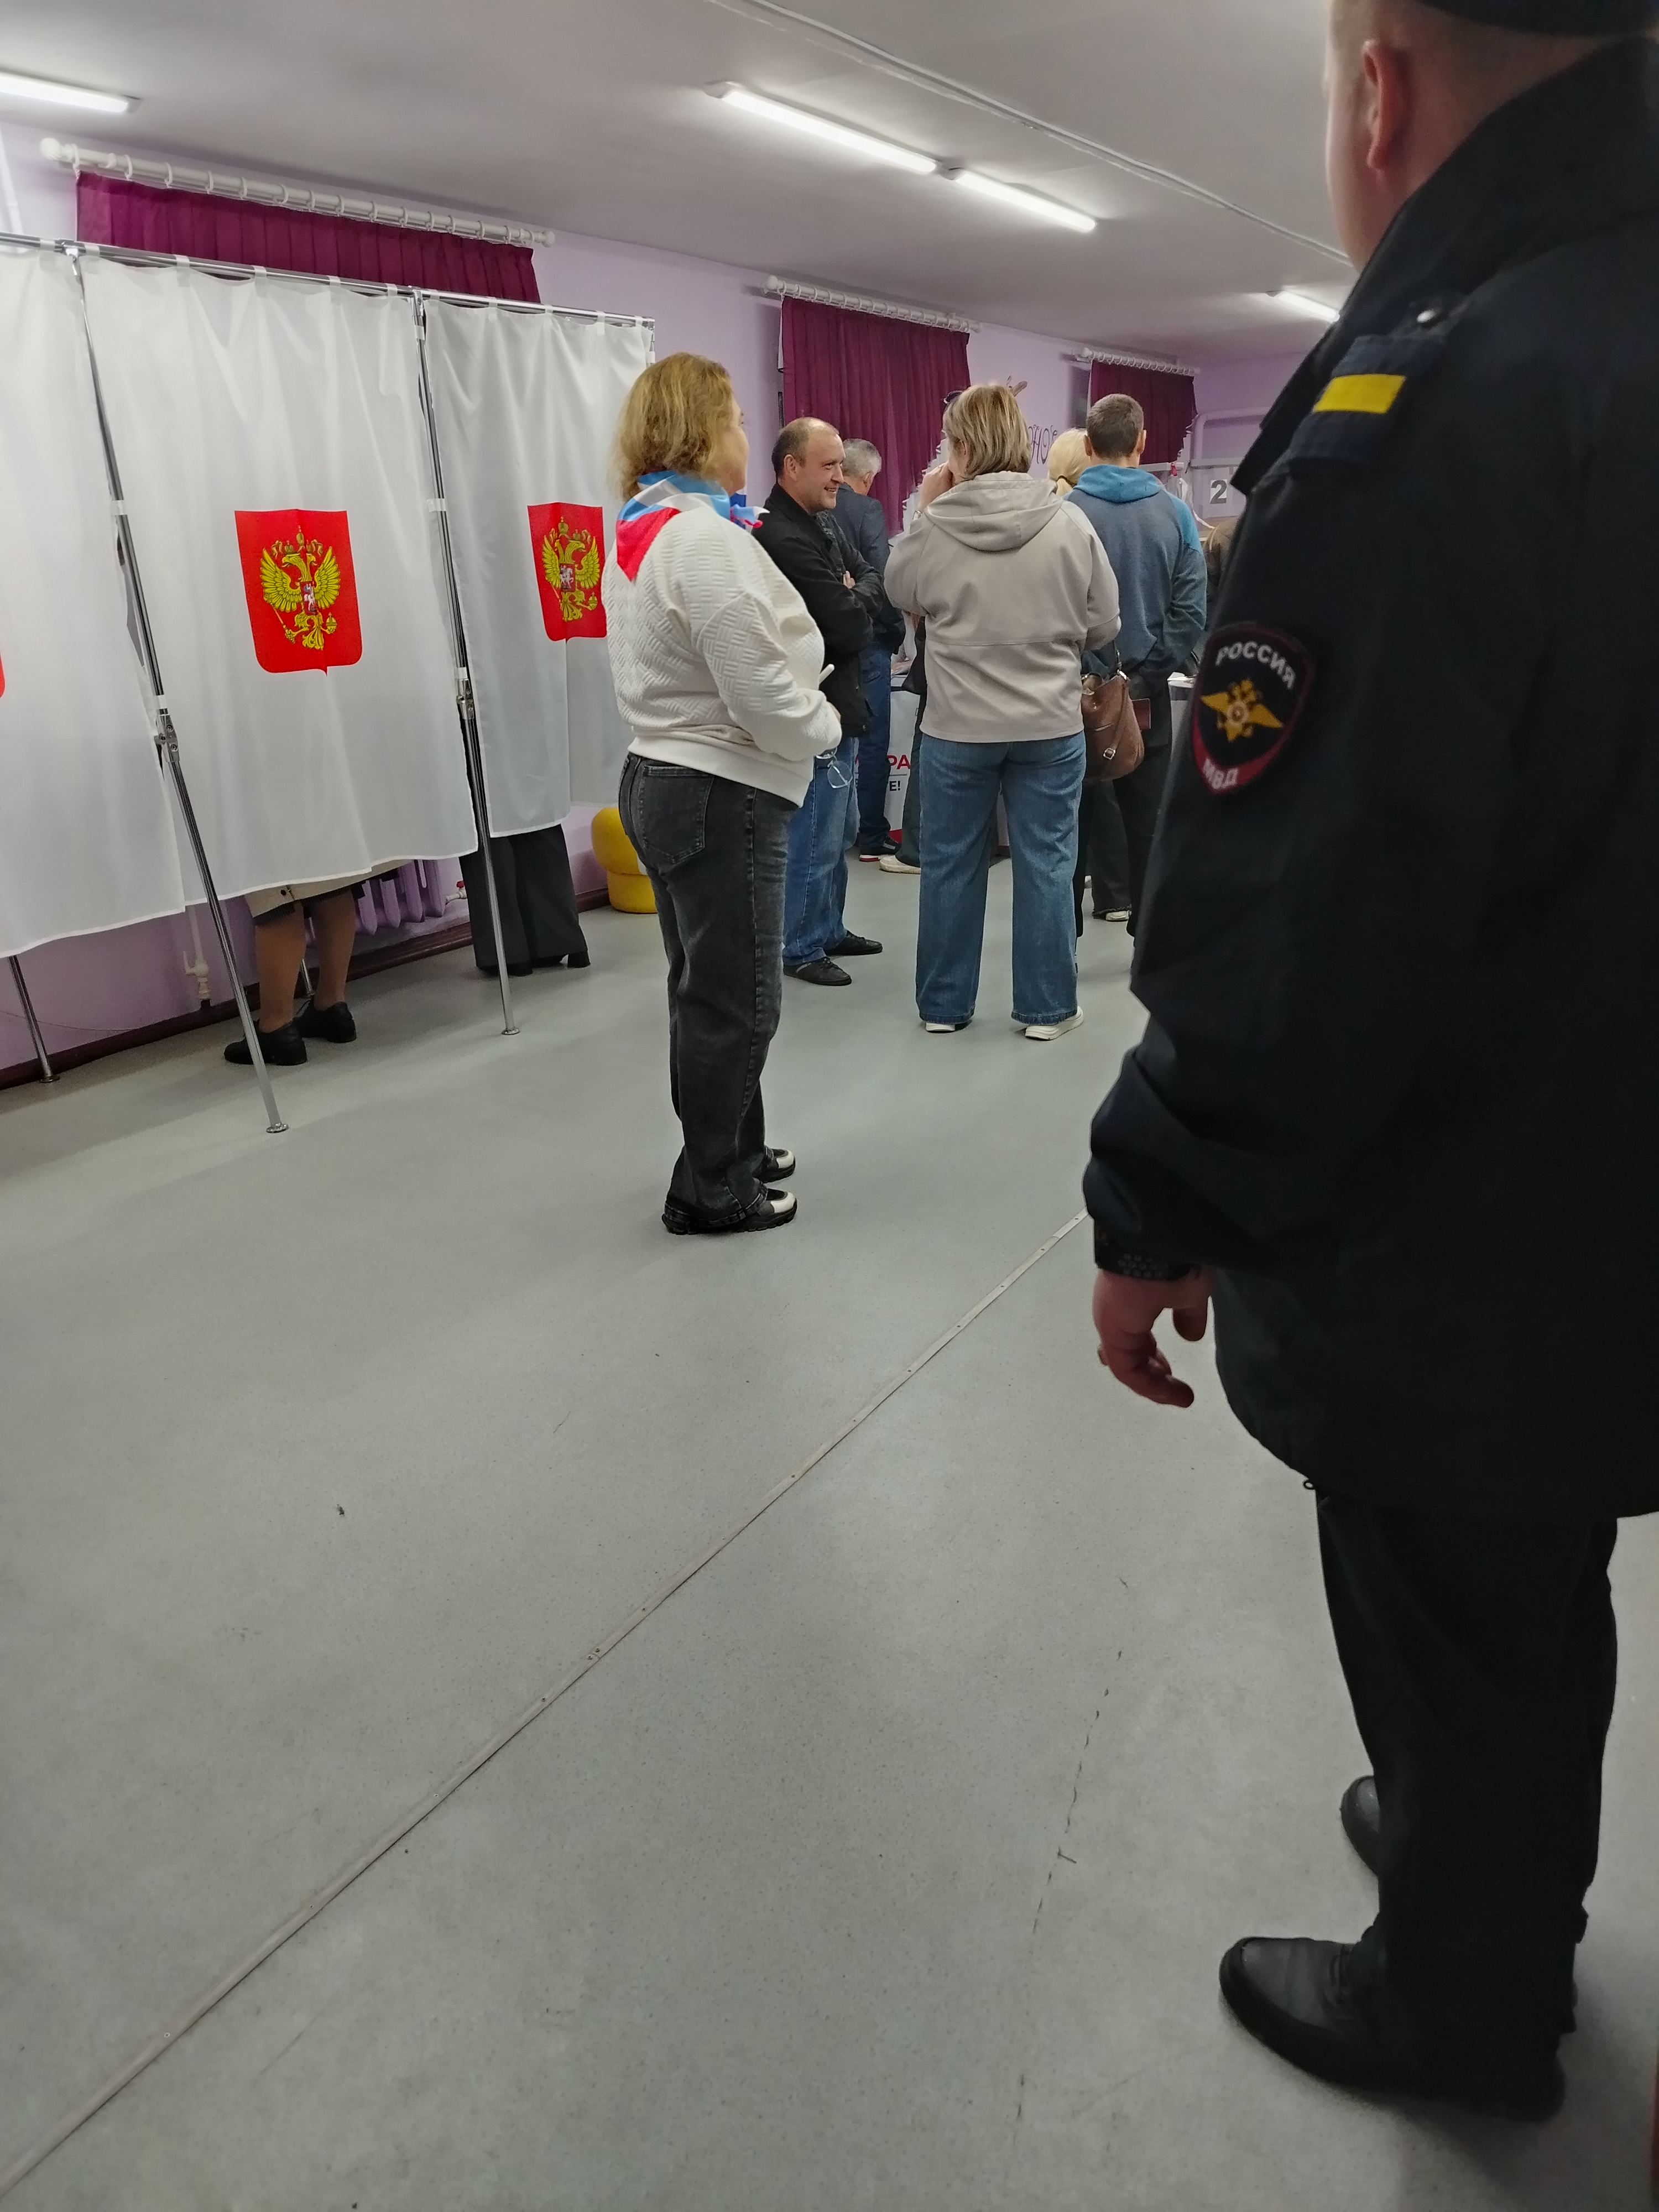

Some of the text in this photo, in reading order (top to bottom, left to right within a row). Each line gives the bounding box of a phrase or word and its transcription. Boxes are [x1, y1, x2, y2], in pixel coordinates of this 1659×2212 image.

[1210, 480, 1227, 504] 2
[1215, 641, 1296, 690] РОССИЯ
[1202, 758, 1238, 790] МВД
